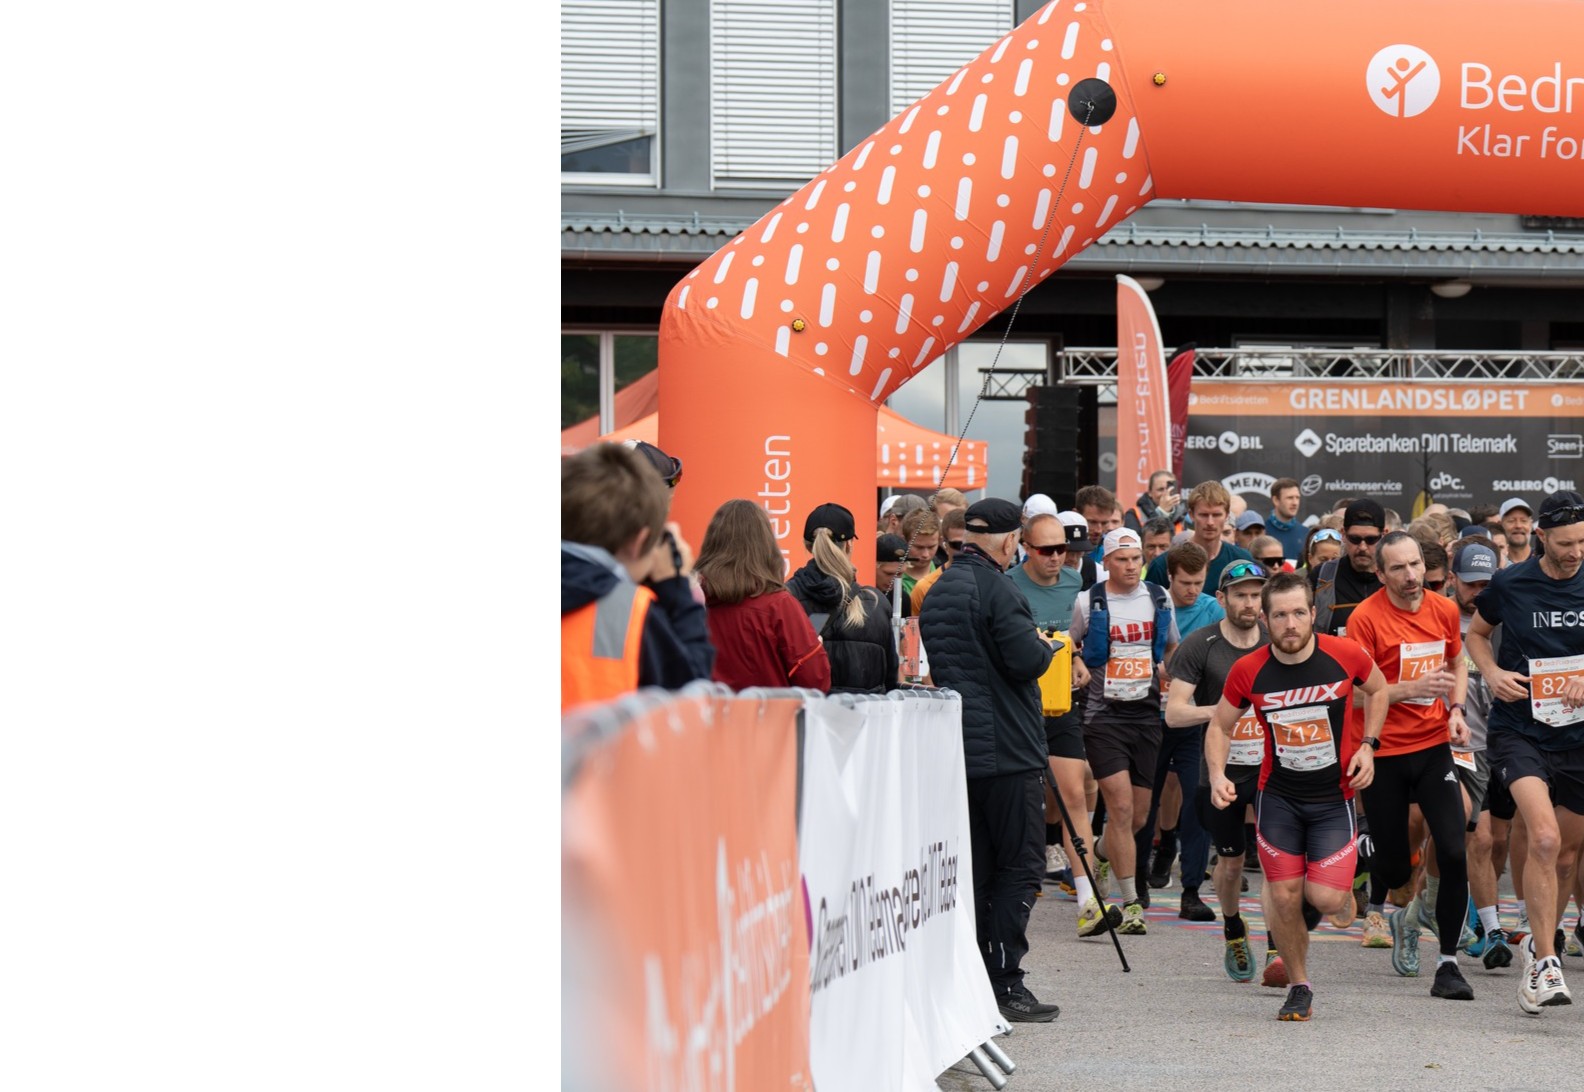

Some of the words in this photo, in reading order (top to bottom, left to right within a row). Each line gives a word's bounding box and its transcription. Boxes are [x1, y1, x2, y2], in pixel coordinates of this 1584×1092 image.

[1457, 126, 1530, 159] Klar
[1289, 388, 1529, 411] GRENLANDSLØPET
[1183, 436, 1216, 449] ERG
[1240, 436, 1263, 449] BIL
[1325, 433, 1419, 456] Sparebanken
[1421, 434, 1448, 452] DIN
[1450, 433, 1517, 453] Telemark
[1229, 478, 1271, 491] MENY
[1325, 479, 1402, 491] reklameservice
[1493, 480, 1541, 491] SOLBERG
[1557, 480, 1576, 491] BIL
[1114, 661, 1144, 676] 795
[1410, 659, 1435, 678] 741
[1542, 675, 1579, 695] 82
[1261, 681, 1343, 711] SWIX
[1231, 721, 1264, 737] 746
[1282, 724, 1321, 743] 712
[1008, 1000, 1031, 1013] HOKA
